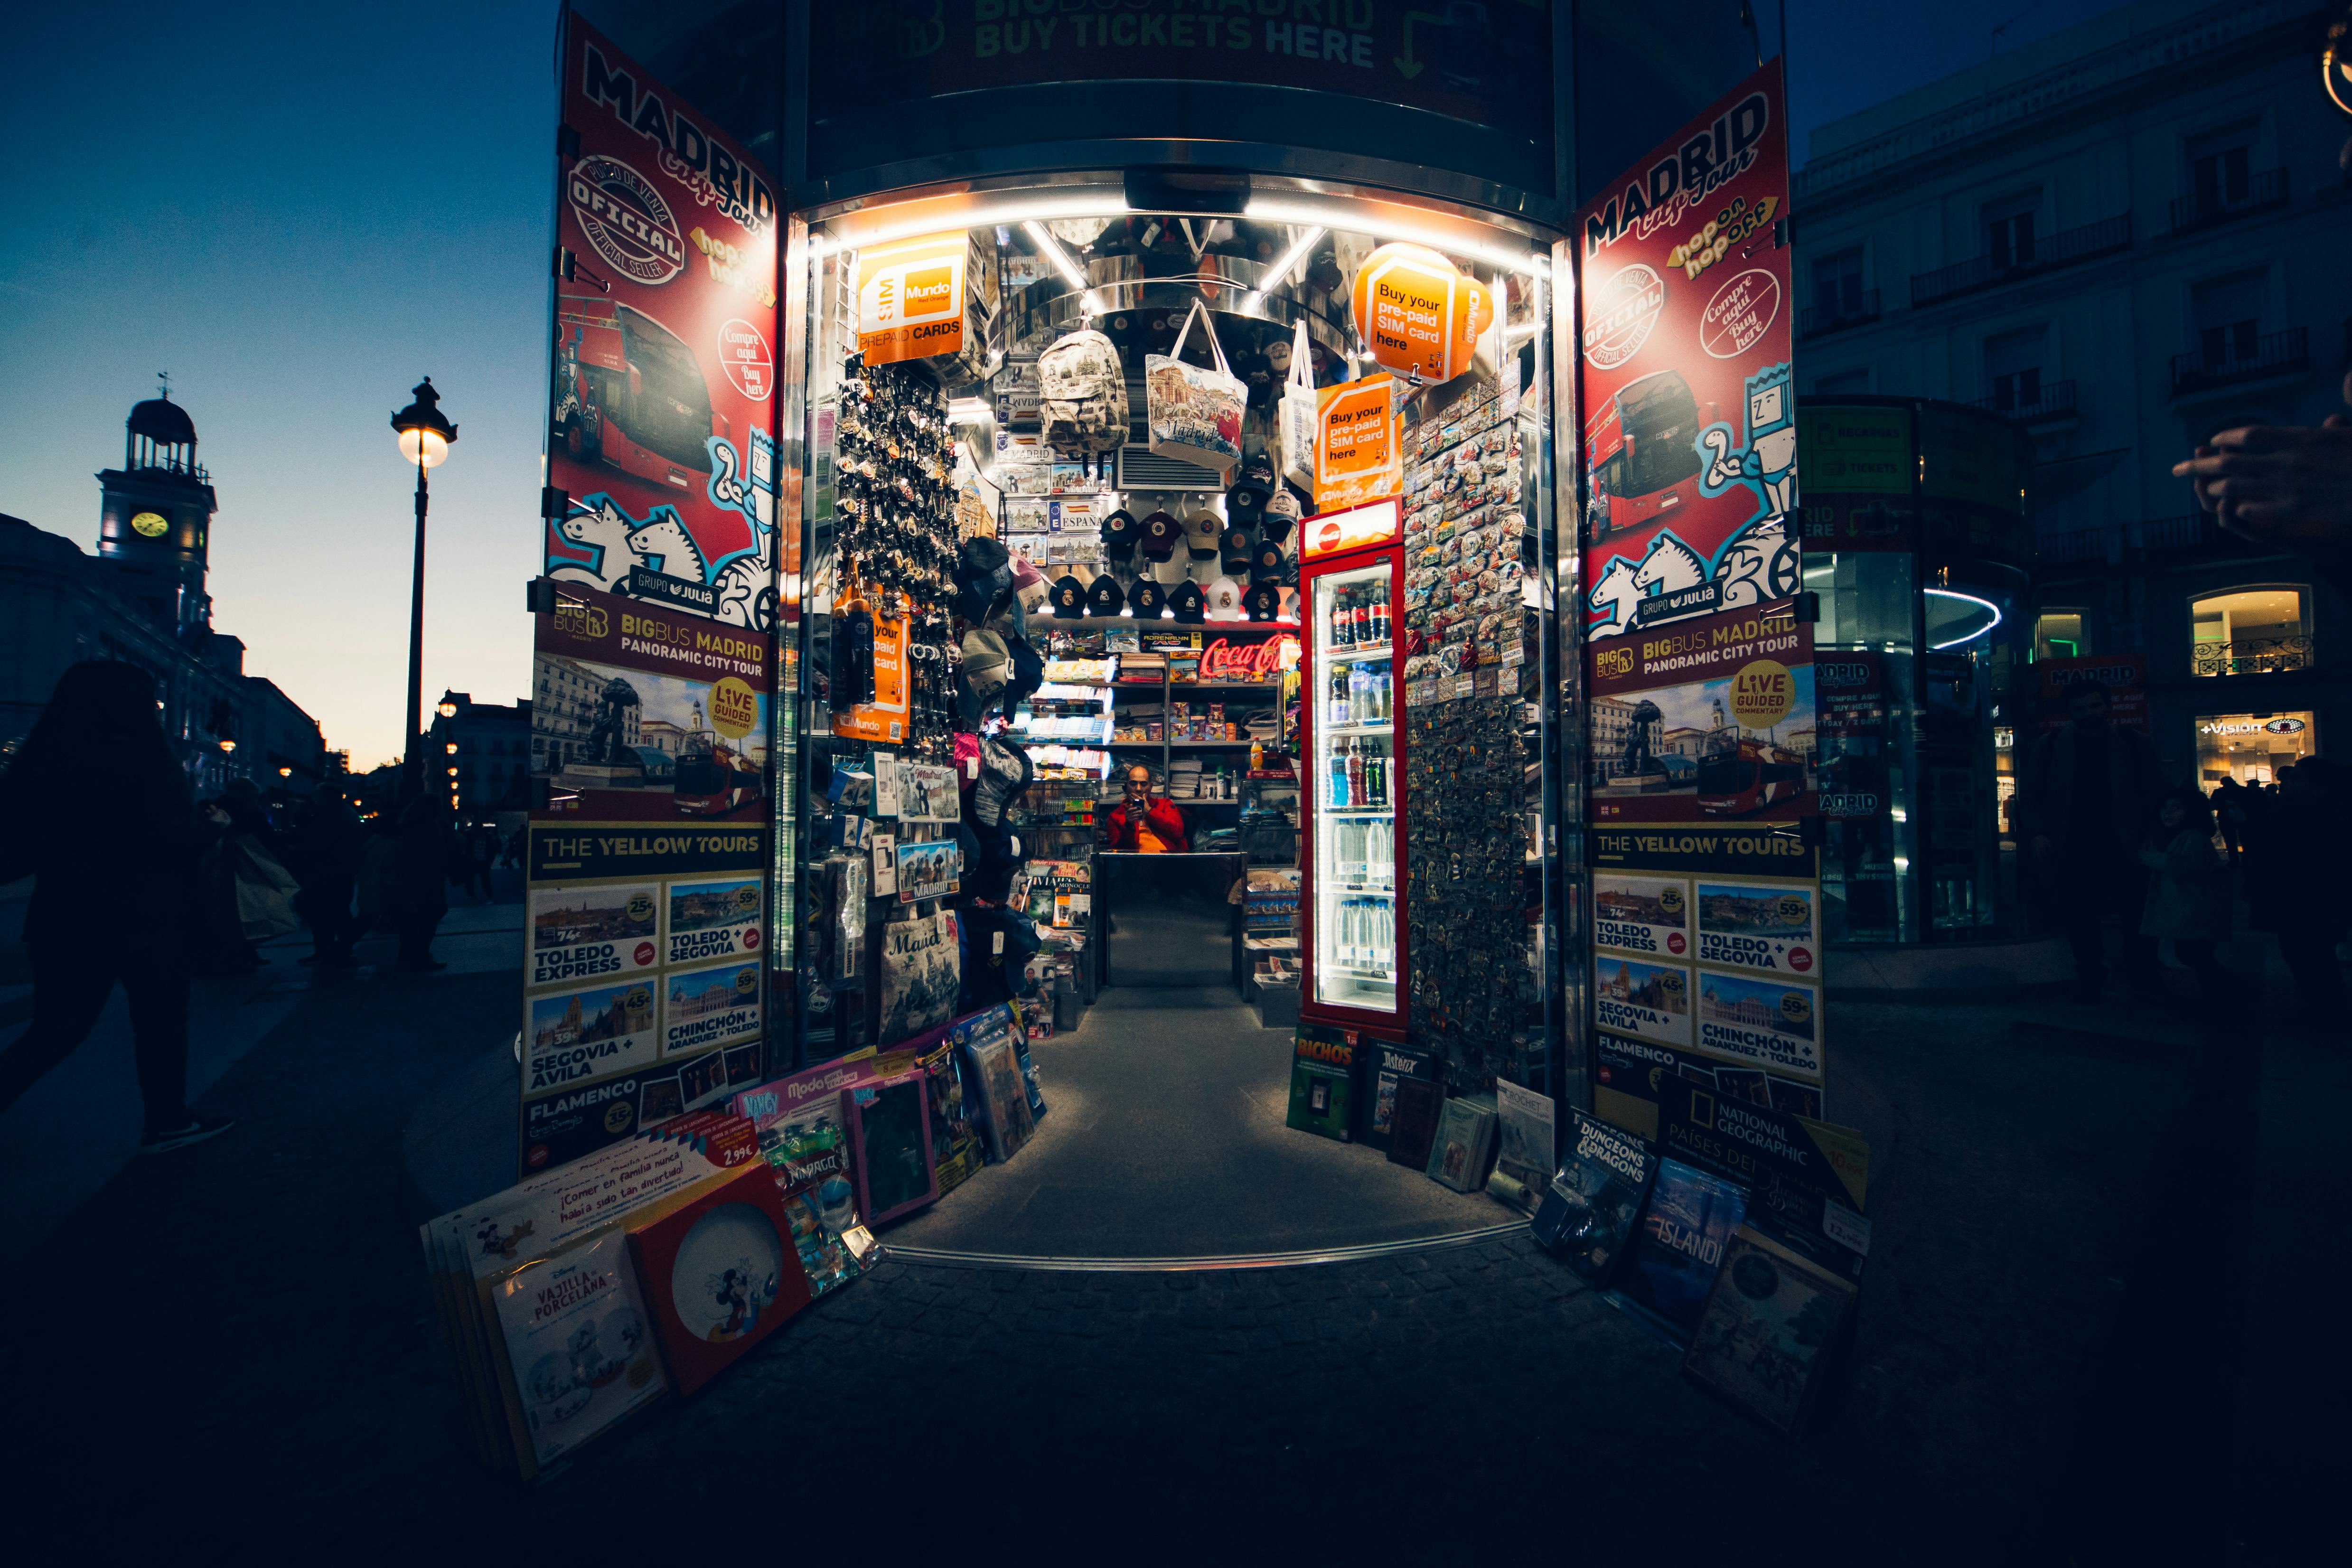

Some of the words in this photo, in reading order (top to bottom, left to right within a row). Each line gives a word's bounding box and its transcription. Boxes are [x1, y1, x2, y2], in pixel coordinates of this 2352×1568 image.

[976, 16, 1057, 58] BUY
[1068, 13, 1250, 50] TICKETS
[1265, 20, 1373, 68] HERE
[583, 39, 776, 230] MADRID
[1585, 92, 1770, 263] MADRID
[639, 185, 668, 222] VENTA
[572, 180, 681, 262] OFICIAL
[587, 222, 627, 270] OFFICIAL
[629, 261, 665, 277] SELLER
[878, 278, 893, 321] SIM
[906, 282, 950, 300] Mundo
[1380, 283, 1406, 304] Buy
[1409, 294, 1441, 312] your
[1707, 275, 1752, 324] Compre
[1378, 301, 1437, 328] pre-paid
[1584, 289, 1661, 348] OFICIAL
[1723, 292, 1752, 326] aquí
[1377, 314, 1405, 335] SIM
[1408, 326, 1440, 344] card
[1467, 304, 1480, 343] Mundo
[1729, 310, 1757, 339] Buy
[725, 329, 759, 349] Compre
[860, 329, 909, 349] PREPAID
[912, 321, 960, 339] CARDS
[1377, 330, 1407, 351] here
[1594, 343, 1621, 365] OFFICIAL
[1621, 324, 1648, 356] SELLER
[1736, 319, 1762, 351] here
[737, 346, 757, 362] aquí
[741, 365, 760, 384] Buy
[746, 381, 763, 396] here
[1331, 412, 1354, 427] Buy
[1356, 405, 1384, 422] your
[1165, 419, 1216, 442] Madrid
[1330, 417, 1381, 439] pre-paid
[1330, 436, 1353, 449] SIM
[1356, 429, 1384, 443] card
[1838, 428, 1899, 438] RECARGAS
[1012, 450, 1049, 459] MADRID
[1330, 448, 1356, 461] here
[1850, 463, 1897, 474] TICKETS
[1063, 515, 1103, 527] ESPAÑA
[1318, 531, 1341, 544] Coca-Cola
[638, 574, 667, 592] GRUPO
[1643, 599, 1668, 616] GRUPO
[554, 616, 585, 634] BUS
[875, 624, 898, 640] your
[1713, 615, 1797, 647] MADRID
[621, 637, 702, 665] PANORAMIC
[704, 655, 731, 670] CITY
[733, 660, 762, 677] TOUR
[696, 632, 763, 662] MADRID
[1503, 649, 1521, 658] MADRID
[1597, 650, 1617, 666] BIG
[1644, 650, 1719, 675] PANORAMIC
[1723, 644, 1754, 660] CITY
[1757, 635, 1798, 654] TOUR
[874, 658, 897, 671] card
[1597, 664, 1617, 677] BUS
[1815, 664, 1870, 680] ADRID
[2051, 666, 2136, 685] MADRID
[1822, 676, 1840, 688] City
[1737, 695, 1785, 708] GUIDED
[1852, 702, 1874, 710] HERE
[713, 715, 750, 730] COMMENTARY
[714, 705, 751, 722] GUIDED
[852, 717, 880, 731] Mundo
[915, 768, 942, 781] Madrid
[1818, 793, 1878, 811] ADRID
[1829, 806, 1849, 818] City
[543, 838, 592, 857] THE
[598, 837, 692, 855] YELLOW
[696, 836, 759, 853] TOURS
[1599, 836, 1631, 851] THE
[1634, 836, 1717, 854] YELLOW
[1723, 837, 1805, 855] TOURS
[914, 881, 948, 898] MADRID
[1780, 902, 1806, 916] 59€
[670, 929, 730, 948] TOLEDO
[1597, 921, 1651, 939] TOLEDO
[670, 941, 735, 962] SEGOVIA
[1597, 933, 1657, 952] EXPRESS
[1700, 933, 1770, 954] TOLEDO
[535, 944, 614, 967] TOLEDO
[1700, 948, 1777, 969] SEGOVIA
[535, 957, 621, 983] EXPRESS
[1599, 1000, 1658, 1024] SEGOVIA
[1782, 998, 1809, 1014] 59€
[668, 1010, 746, 1041] CHINCHÓN
[1599, 1014, 1639, 1032] AVILA
[668, 1032, 717, 1051] ARANJUEZ
[726, 1021, 759, 1036] TOLEDO
[1702, 1023, 1796, 1056] CHINCHÓN
[531, 1041, 619, 1074] SEGOVIA
[1297, 1038, 1353, 1065] BICHOS
[1599, 1036, 1674, 1066] FLAMENCO
[1702, 1036, 1758, 1058] ARANJUEZ
[1769, 1052, 1817, 1070] TOLEDO
[531, 1065, 593, 1090] AVILA
[530, 1080, 636, 1121] FLAMENCO
[742, 1090, 779, 1121] NANCY
[788, 1078, 824, 1100] Moda
[853, 1086, 875, 1105] NANCY
[1719, 1102, 1789, 1142] NATIONAL
[1580, 1121, 1645, 1167] DUNGEONS
[1669, 1123, 1722, 1157] PAÍSES
[1717, 1118, 1809, 1166] GEOGRAPHIC
[1577, 1135, 1591, 1159] &
[1588, 1140, 1645, 1183] DRAGONS
[560, 1203, 592, 1223] había
[597, 1194, 617, 1209] sido
[621, 1187, 637, 1198] tan
[641, 1161, 683, 1189] divertido!
[561, 1185, 599, 1210] ¡Comer
[603, 1180, 616, 1189] en
[620, 1164, 651, 1182] familia
[655, 1152, 679, 1168] nunca
[534, 1275, 607, 1321] PORCELANA
[537, 1271, 590, 1304] VAJILLA
